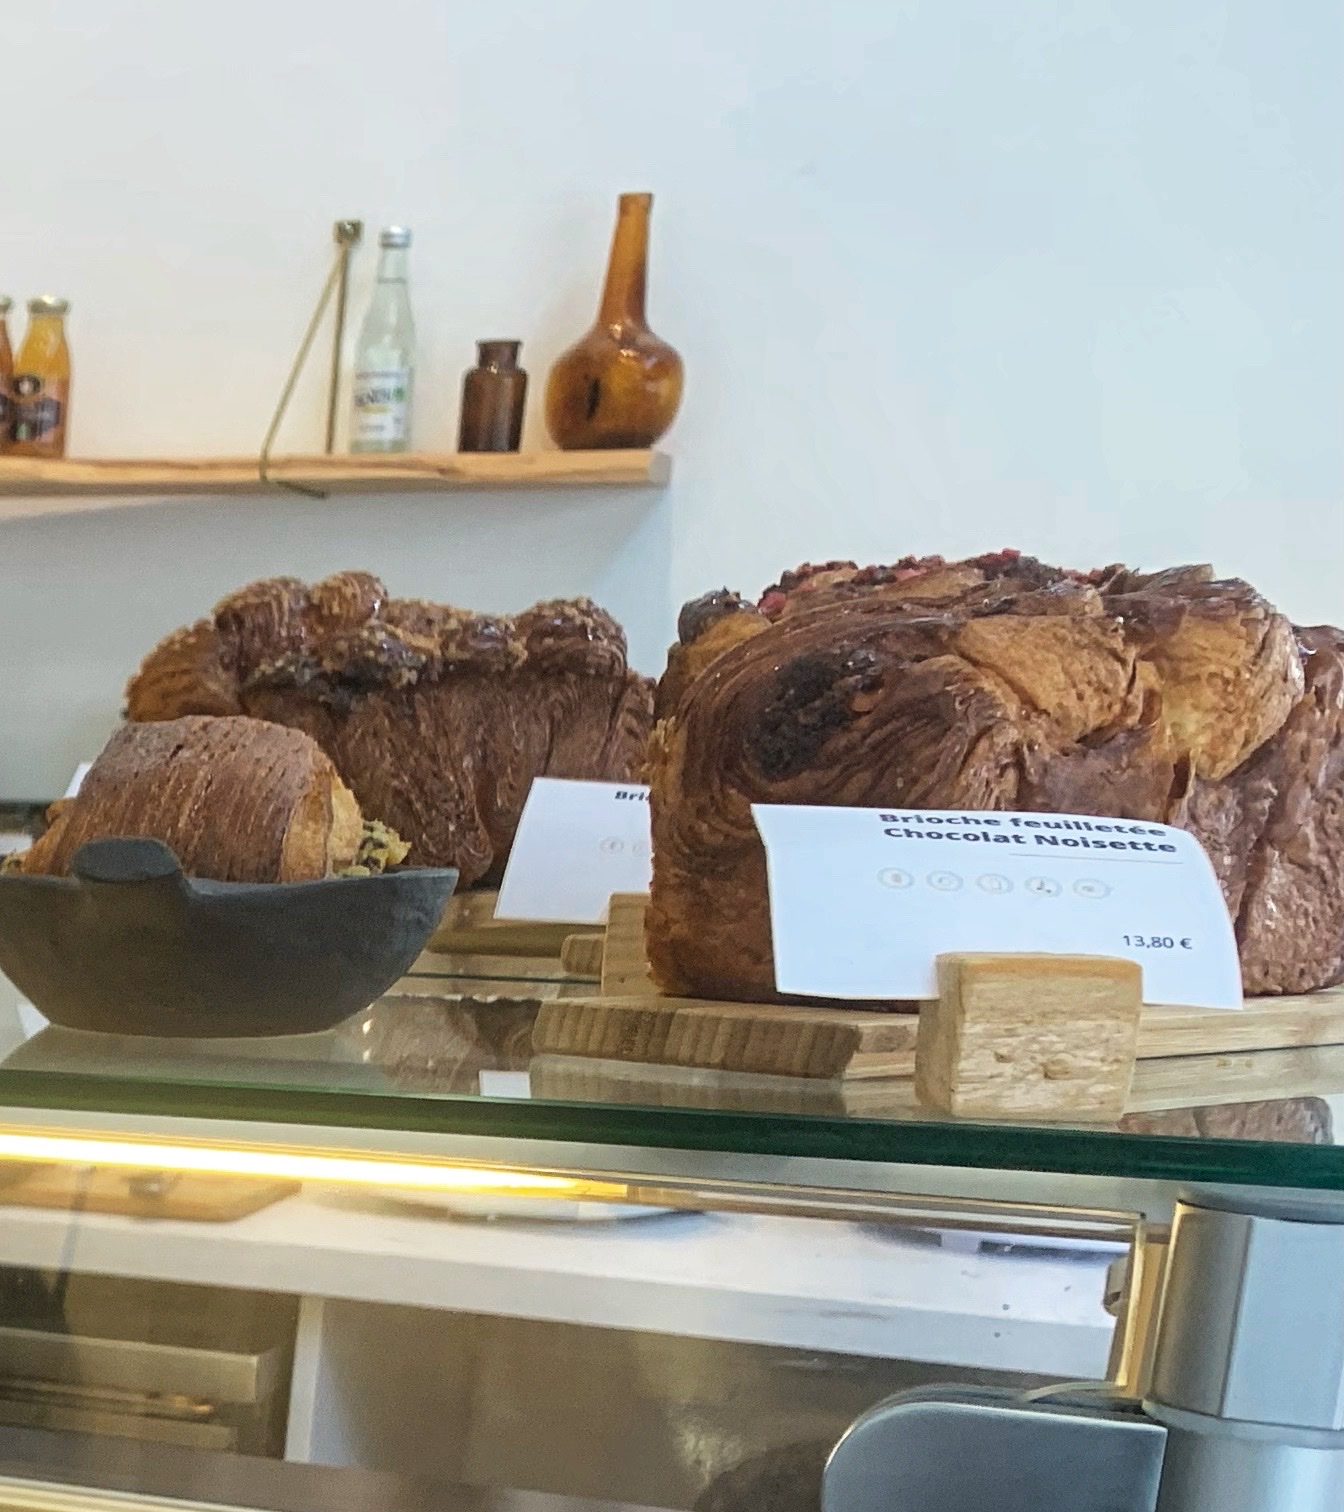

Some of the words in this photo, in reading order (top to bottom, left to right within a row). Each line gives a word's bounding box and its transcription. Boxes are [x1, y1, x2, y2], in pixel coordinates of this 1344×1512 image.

[879, 814, 1001, 827] Brioche
[1009, 817, 1167, 837] feuilletée
[884, 828, 1026, 845] Chocolat
[1035, 834, 1177, 853] Noisette
[1122, 935, 1174, 950] 13,80
[1180, 937, 1193, 950] €
